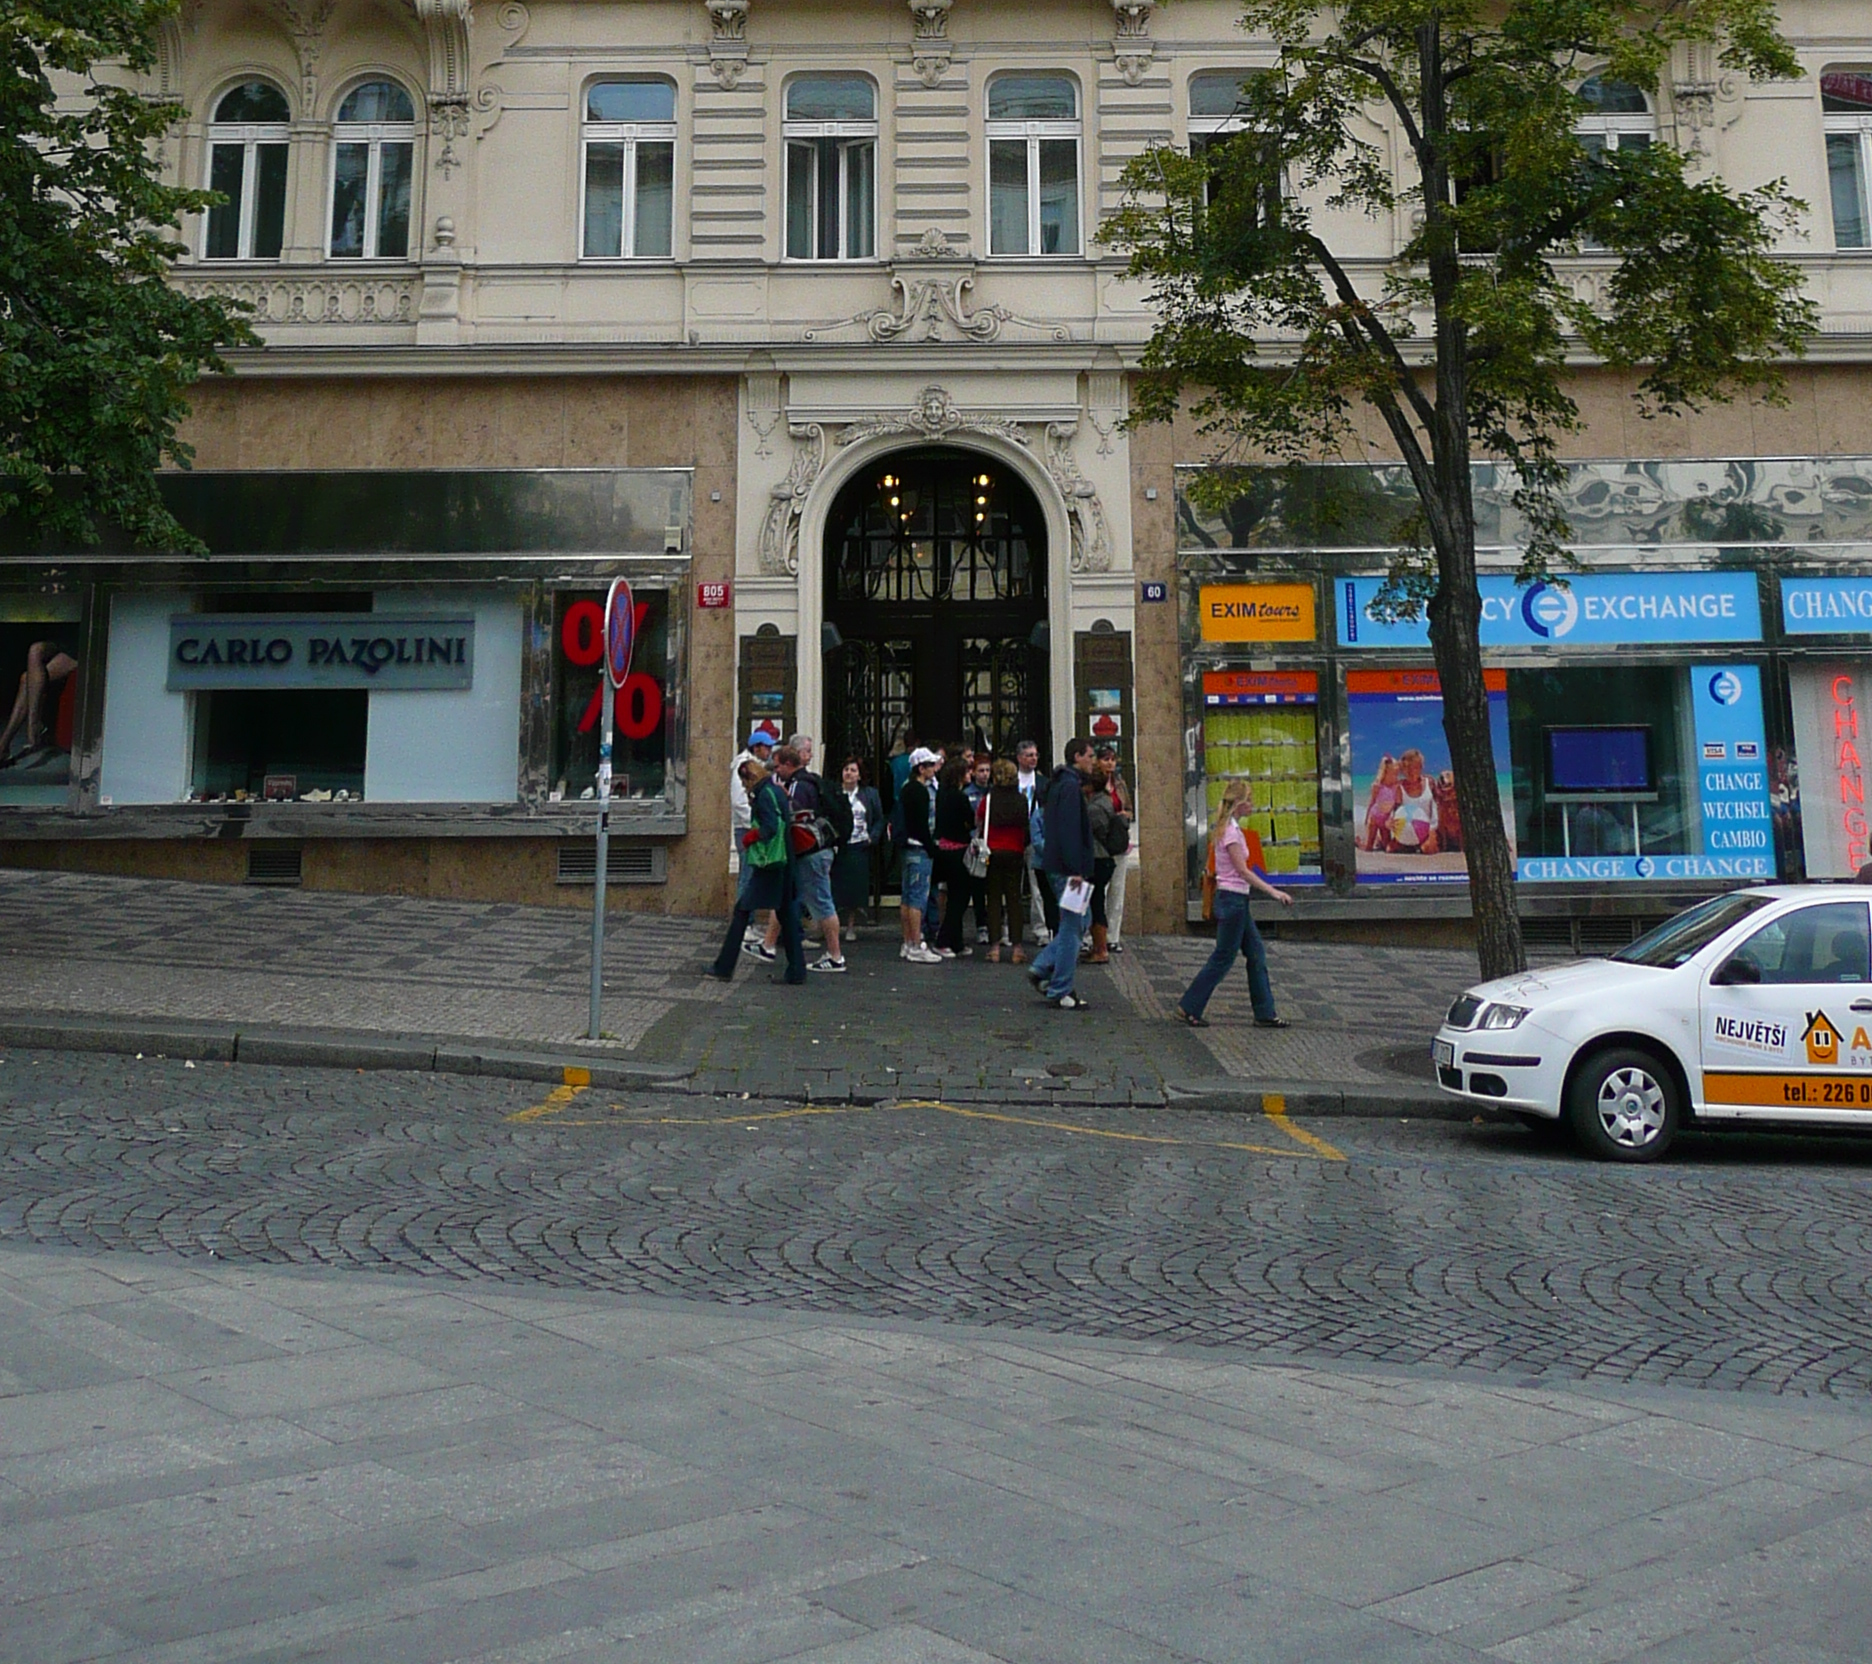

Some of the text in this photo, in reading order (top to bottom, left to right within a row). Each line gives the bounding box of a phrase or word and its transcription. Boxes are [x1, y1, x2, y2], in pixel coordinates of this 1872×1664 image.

[703, 585, 724, 597] 805
[1147, 586, 1161, 598] 60
[1211, 601, 1300, 618] EXIM tours
[1585, 594, 1736, 620] EXCHANGE
[176, 636, 466, 674] CARLO PAZOLINI
[1705, 773, 1762, 791] CHANGE
[1832, 675, 1868, 874] CHANGE
[1703, 801, 1769, 819] WECHSEL
[1711, 830, 1766, 848] CAMBIO
[1523, 857, 1768, 878] CHANGE CHANGE
[1715, 1016, 1788, 1047] NEJVĚTŠÍ
[1783, 1082, 1872, 1103] tel.: 226 0
